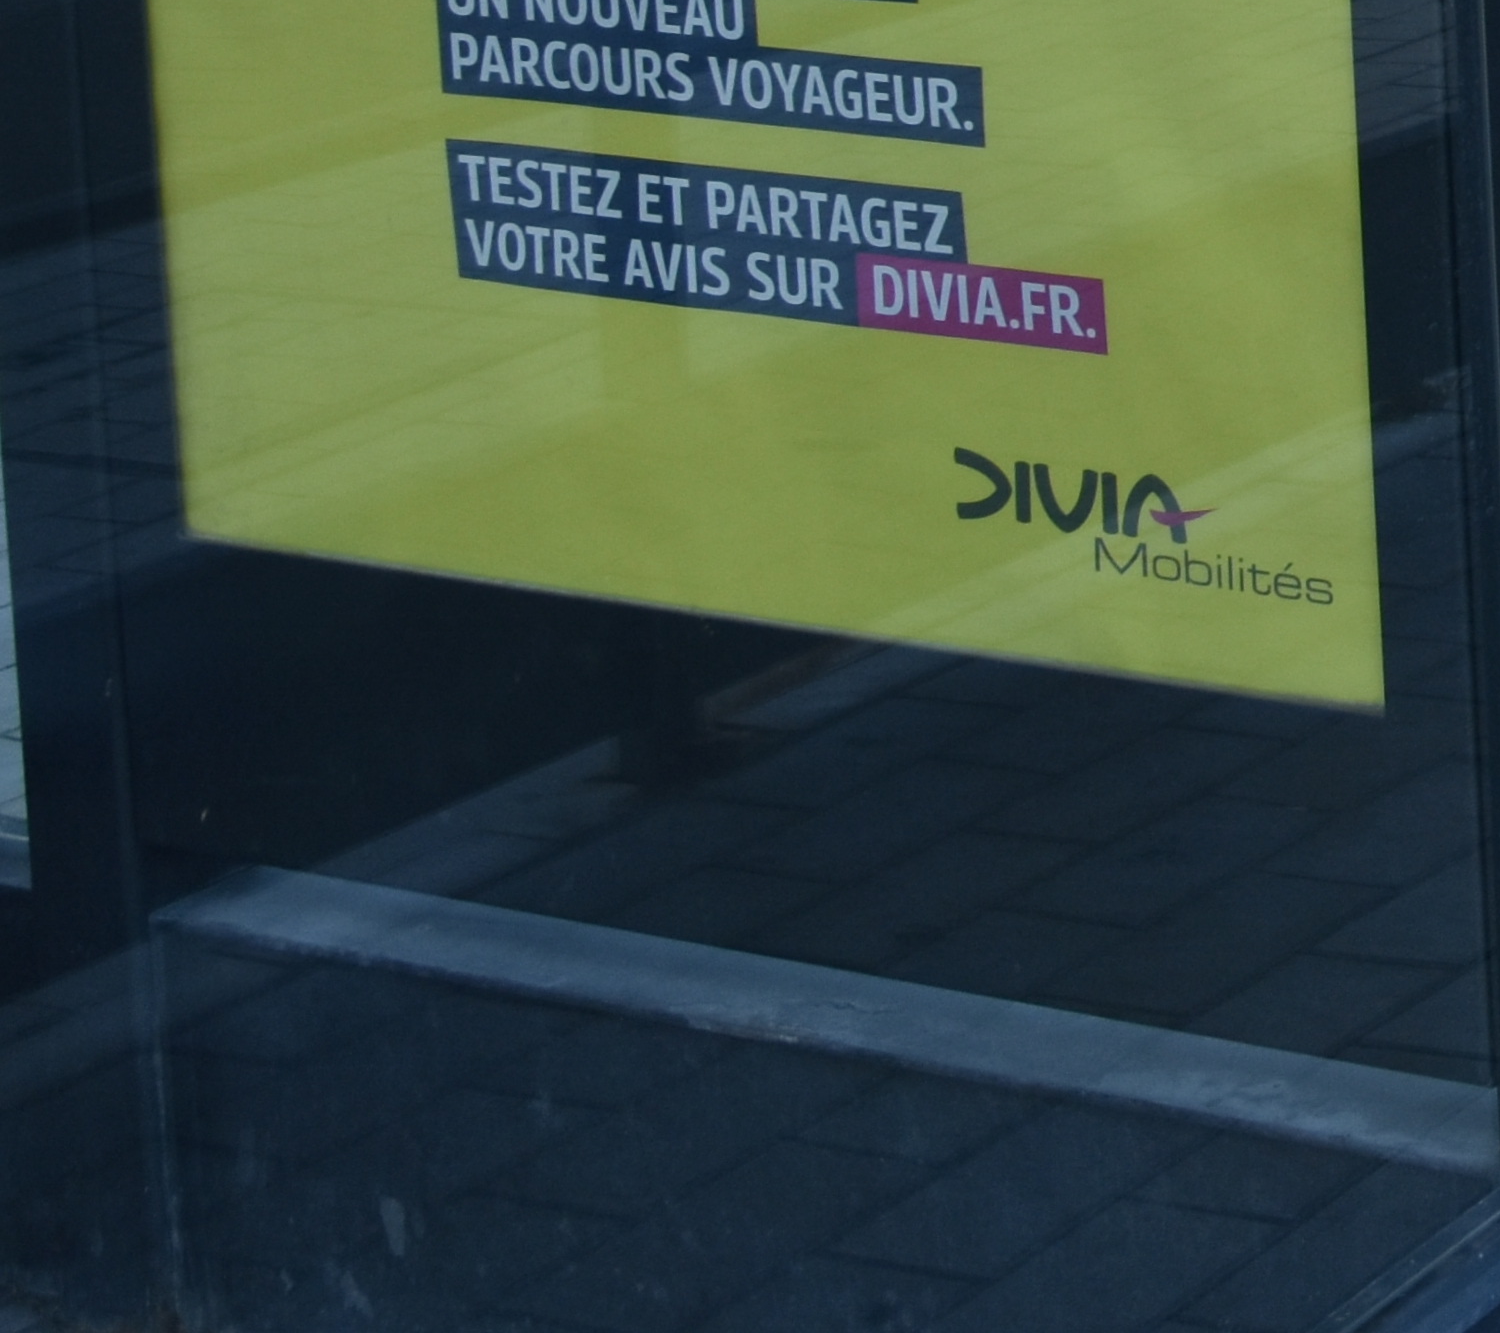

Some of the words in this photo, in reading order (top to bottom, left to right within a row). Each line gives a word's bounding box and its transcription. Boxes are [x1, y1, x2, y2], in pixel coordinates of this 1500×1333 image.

[450, 32, 694, 103] PARCOURS
[709, 57, 974, 131] VOYAGEUR.
[458, 153, 621, 219] TESTEZ
[638, 175, 688, 226] ET
[706, 180, 952, 253] PARTAGEZ
[465, 218, 609, 283] VOTRE
[624, 236, 730, 296] AVIS
[747, 253, 842, 310] SUR
[871, 264, 1098, 338] DIVIA.FR.
[953, 446, 1210, 543] DIVIA
[1094, 536, 1335, 606] Mobilités
